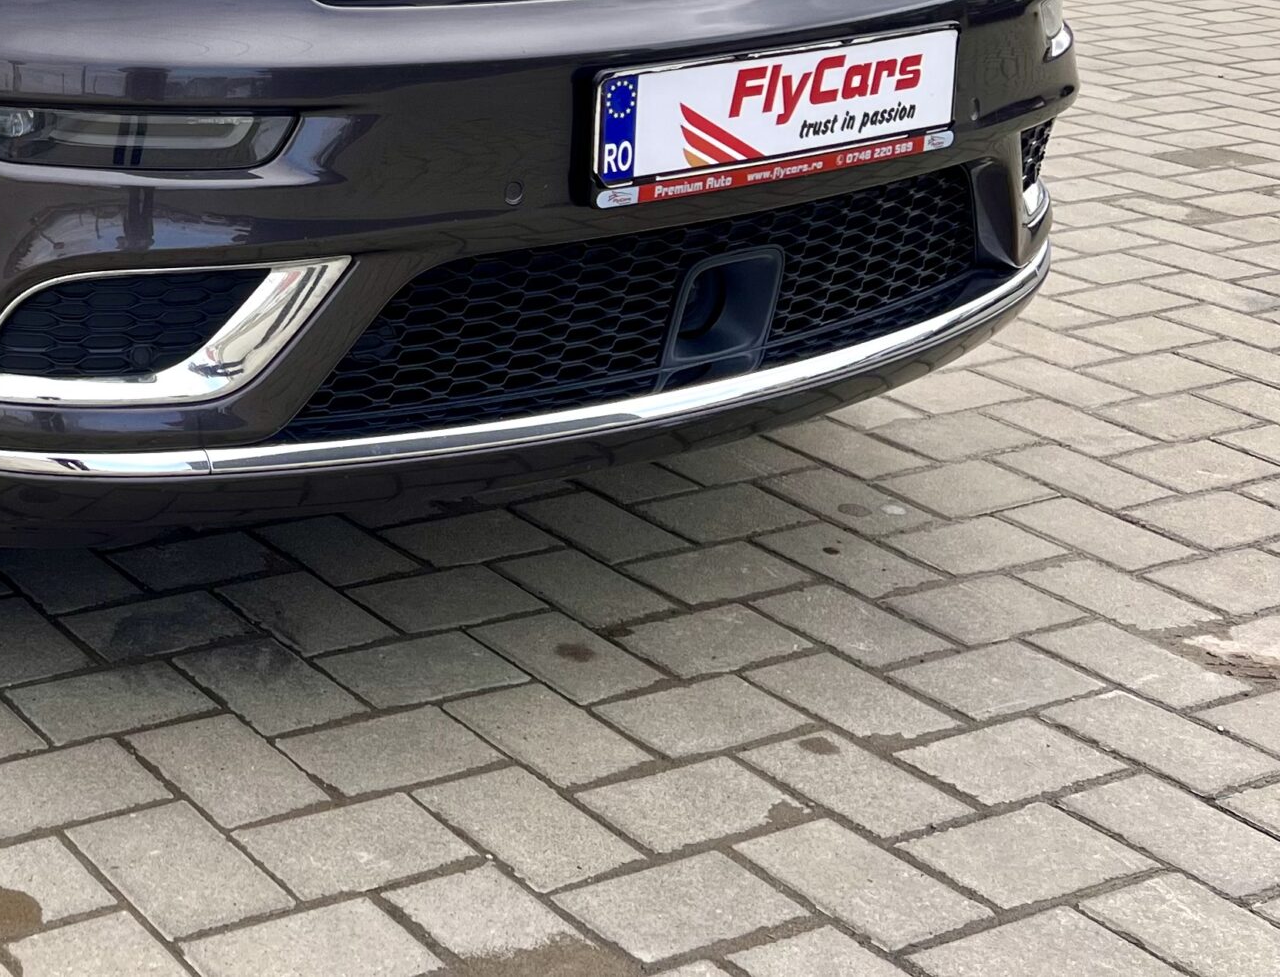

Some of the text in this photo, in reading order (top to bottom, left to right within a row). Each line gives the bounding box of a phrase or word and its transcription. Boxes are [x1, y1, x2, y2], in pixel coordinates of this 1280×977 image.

[728, 53, 923, 126] FlyCars
[799, 101, 916, 139] trust in passion
[603, 140, 632, 174] RO
[873, 146, 893, 159] 220
[747, 160, 823, 182] www.flycars.ro
[654, 175, 732, 198] Premium Auto
